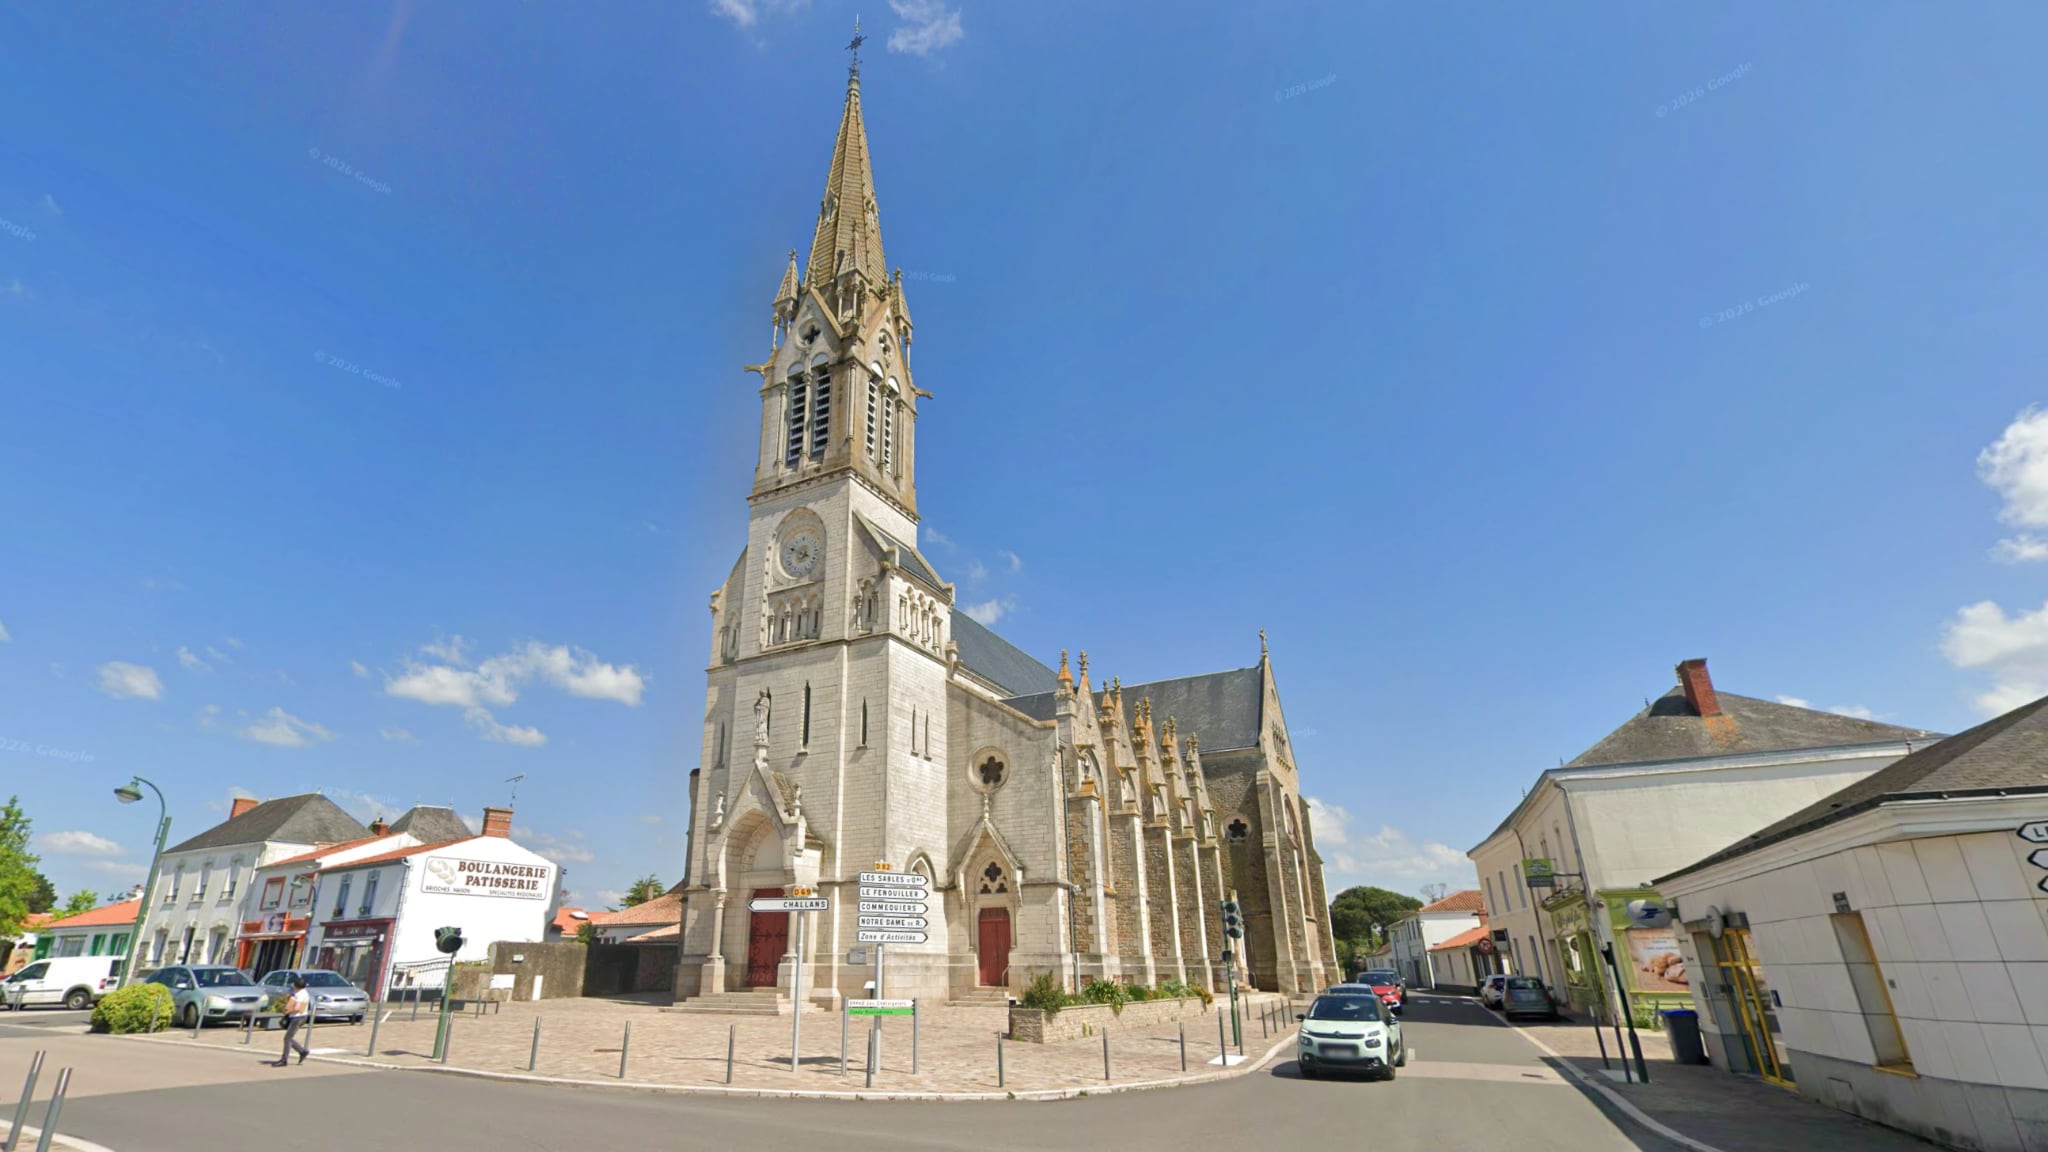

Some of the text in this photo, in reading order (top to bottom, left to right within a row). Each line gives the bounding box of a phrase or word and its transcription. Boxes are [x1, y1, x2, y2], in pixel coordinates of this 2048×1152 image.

[458, 861, 547, 879] BOULANGERIE
[465, 875, 539, 890] PATISSERIE
[862, 874, 875, 882] LES
[873, 889, 918, 897] FENOUILLER
[861, 903, 917, 912] COMMEQUIERS
